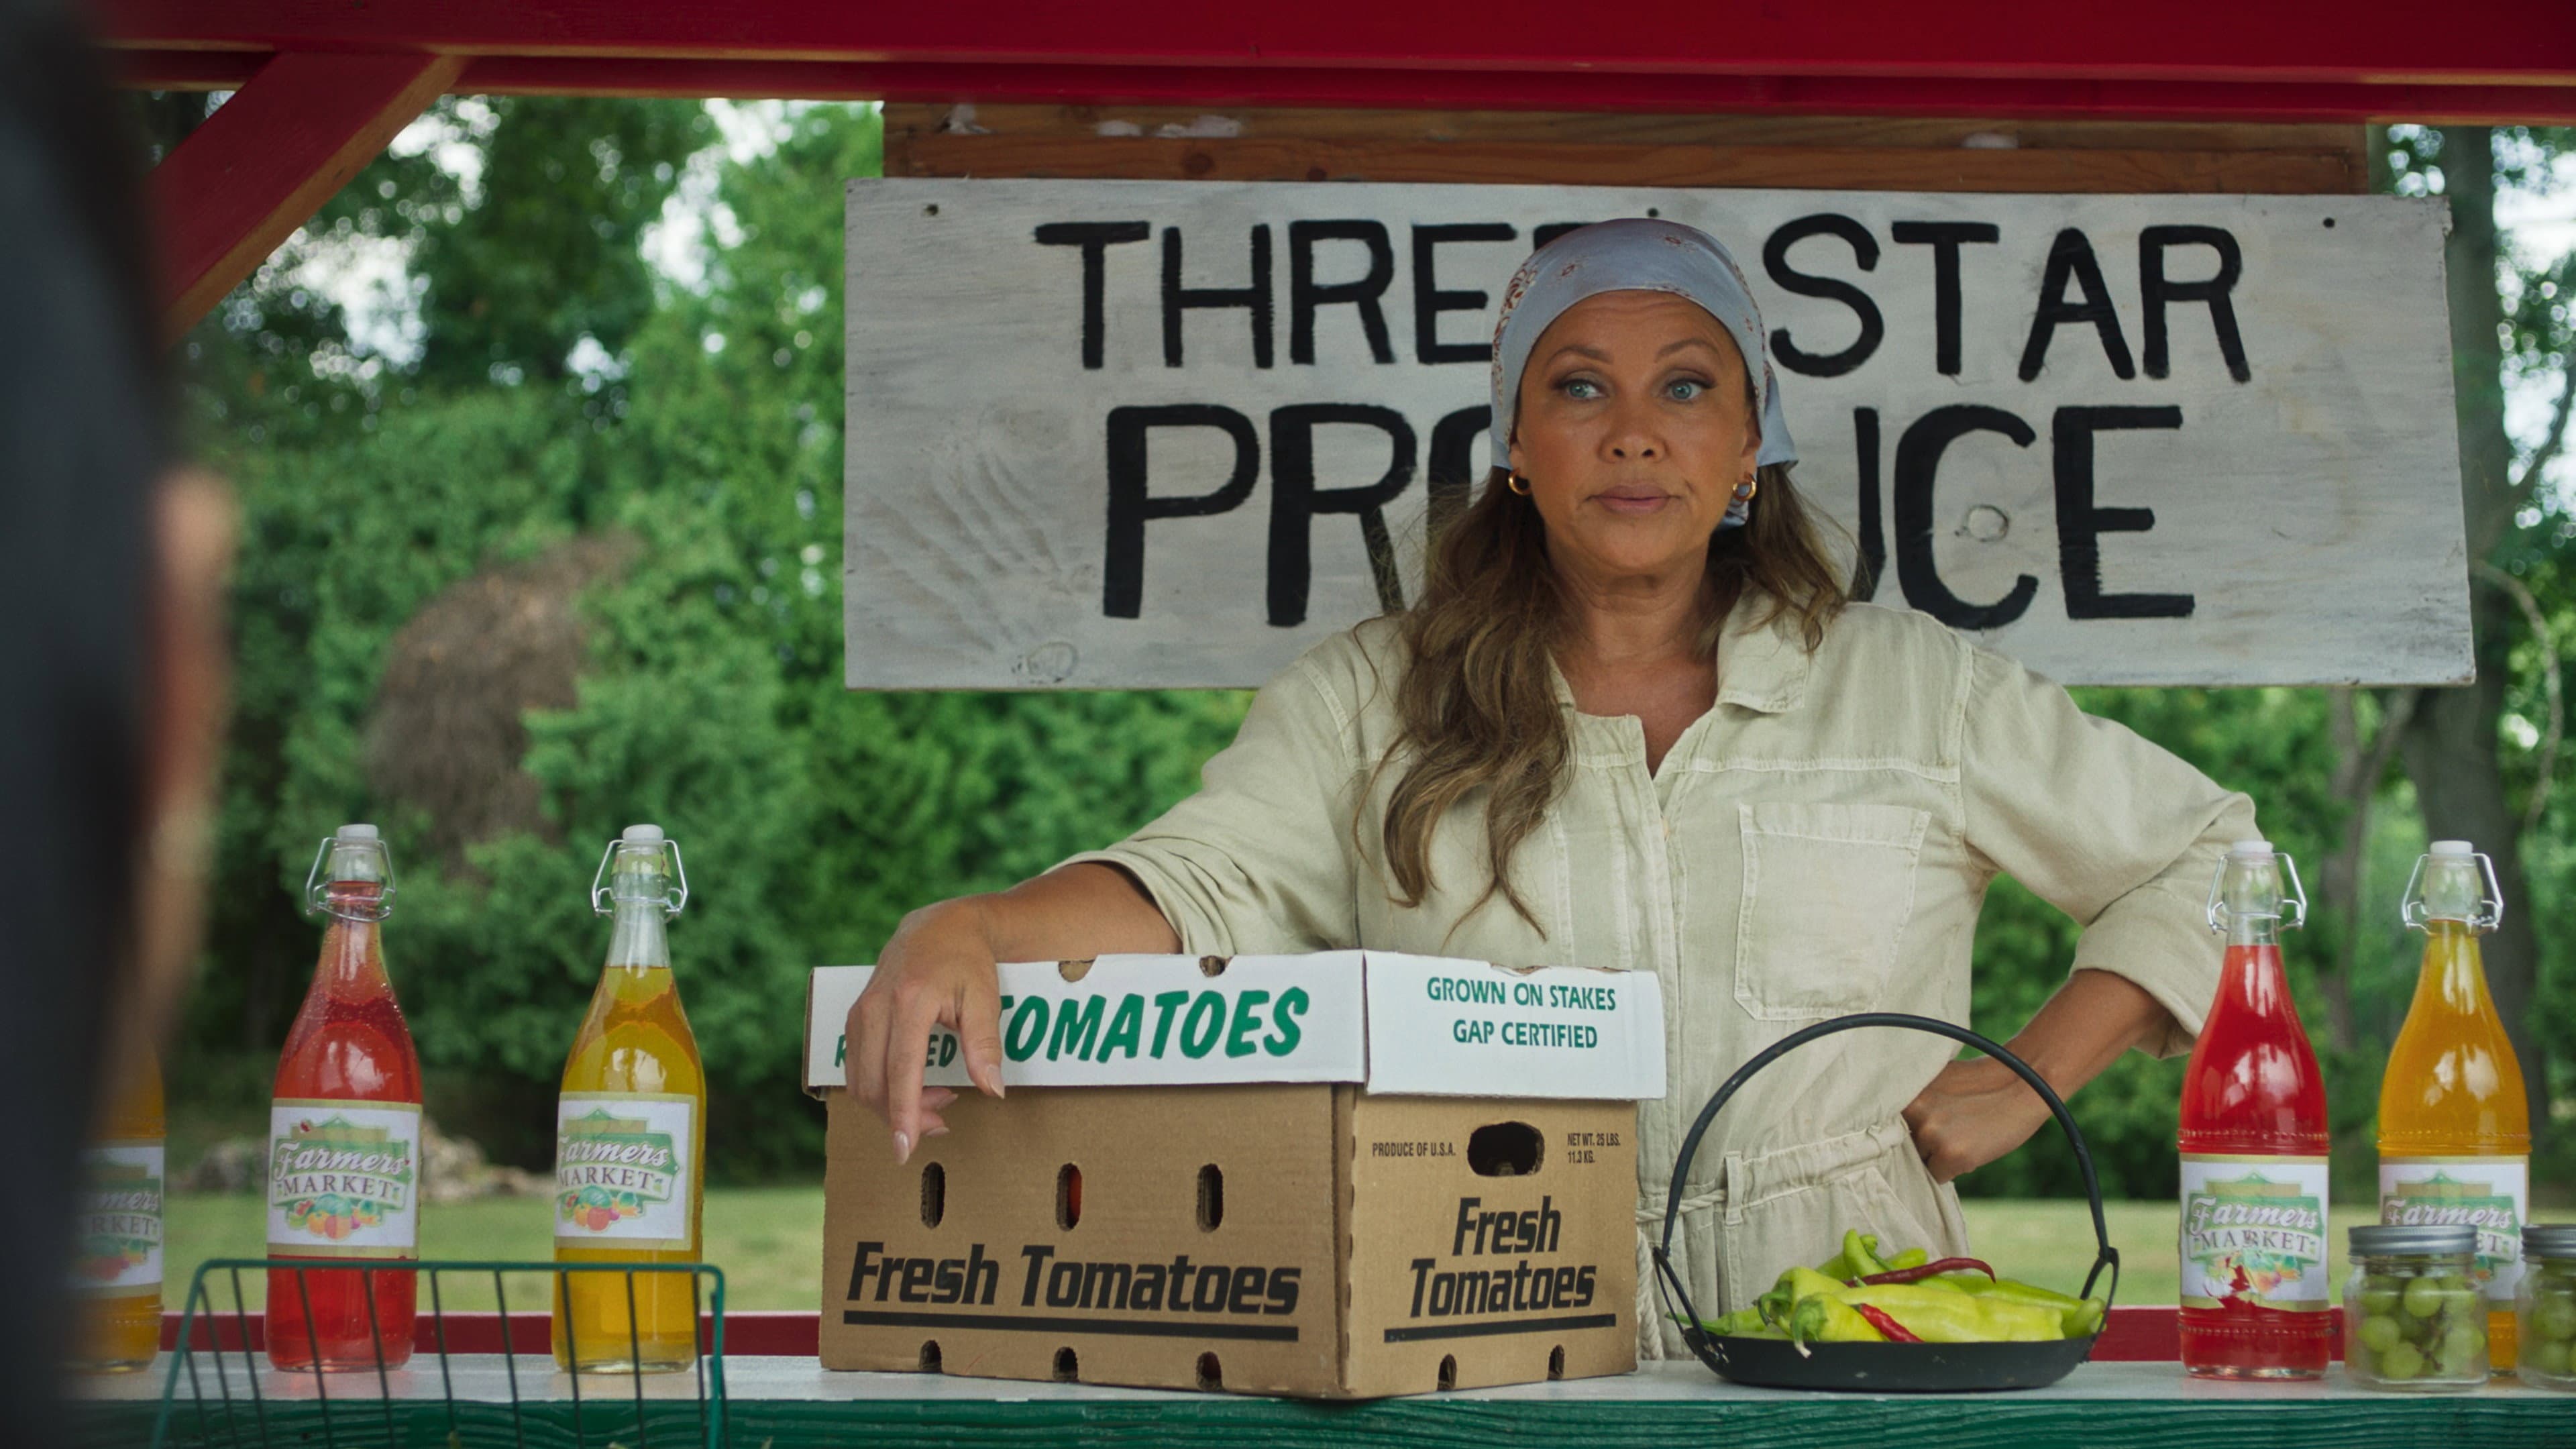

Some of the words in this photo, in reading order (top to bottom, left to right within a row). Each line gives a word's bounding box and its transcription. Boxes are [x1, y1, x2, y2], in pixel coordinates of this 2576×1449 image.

[1034, 220, 1599, 370] THRE
[1761, 212, 2252, 384] STAR
[1103, 402, 2196, 632] PRCE
[1427, 977, 1506, 1005] GROWN
[1513, 983, 1544, 1007] ON
[1550, 985, 1617, 1012] STAKES
[1000, 985, 1310, 1064] OMATOES
[1453, 1019, 1495, 1044] GAP
[1501, 1022, 1599, 1049] CERTIFIED
[1373, 1142, 1414, 1157] PRODUCE
[1416, 1142, 1428, 1157] OF
[1430, 1142, 1456, 1157] U.S.A.
[1567, 1132, 1581, 1147] NET
[1582, 1133, 1595, 1147] WT.
[1597, 1133, 1605, 1146] 25
[1606, 1132, 1621, 1146] LBS.
[1568, 1150, 1583, 1164] 11.3
[1584, 1150, 1596, 1163] KG.
[274, 1142, 407, 1181] Farmers
[283, 1175, 393, 1198] MARKET
[1452, 1195, 1561, 1256] Fresh
[2189, 1197, 2318, 1236] Farmers
[2201, 1229, 2310, 1252] MARKET
[847, 1241, 1000, 1305] Fresh
[1020, 1244, 1302, 1316] Tomatoes
[1410, 1258, 1597, 1318] Tomatoes
